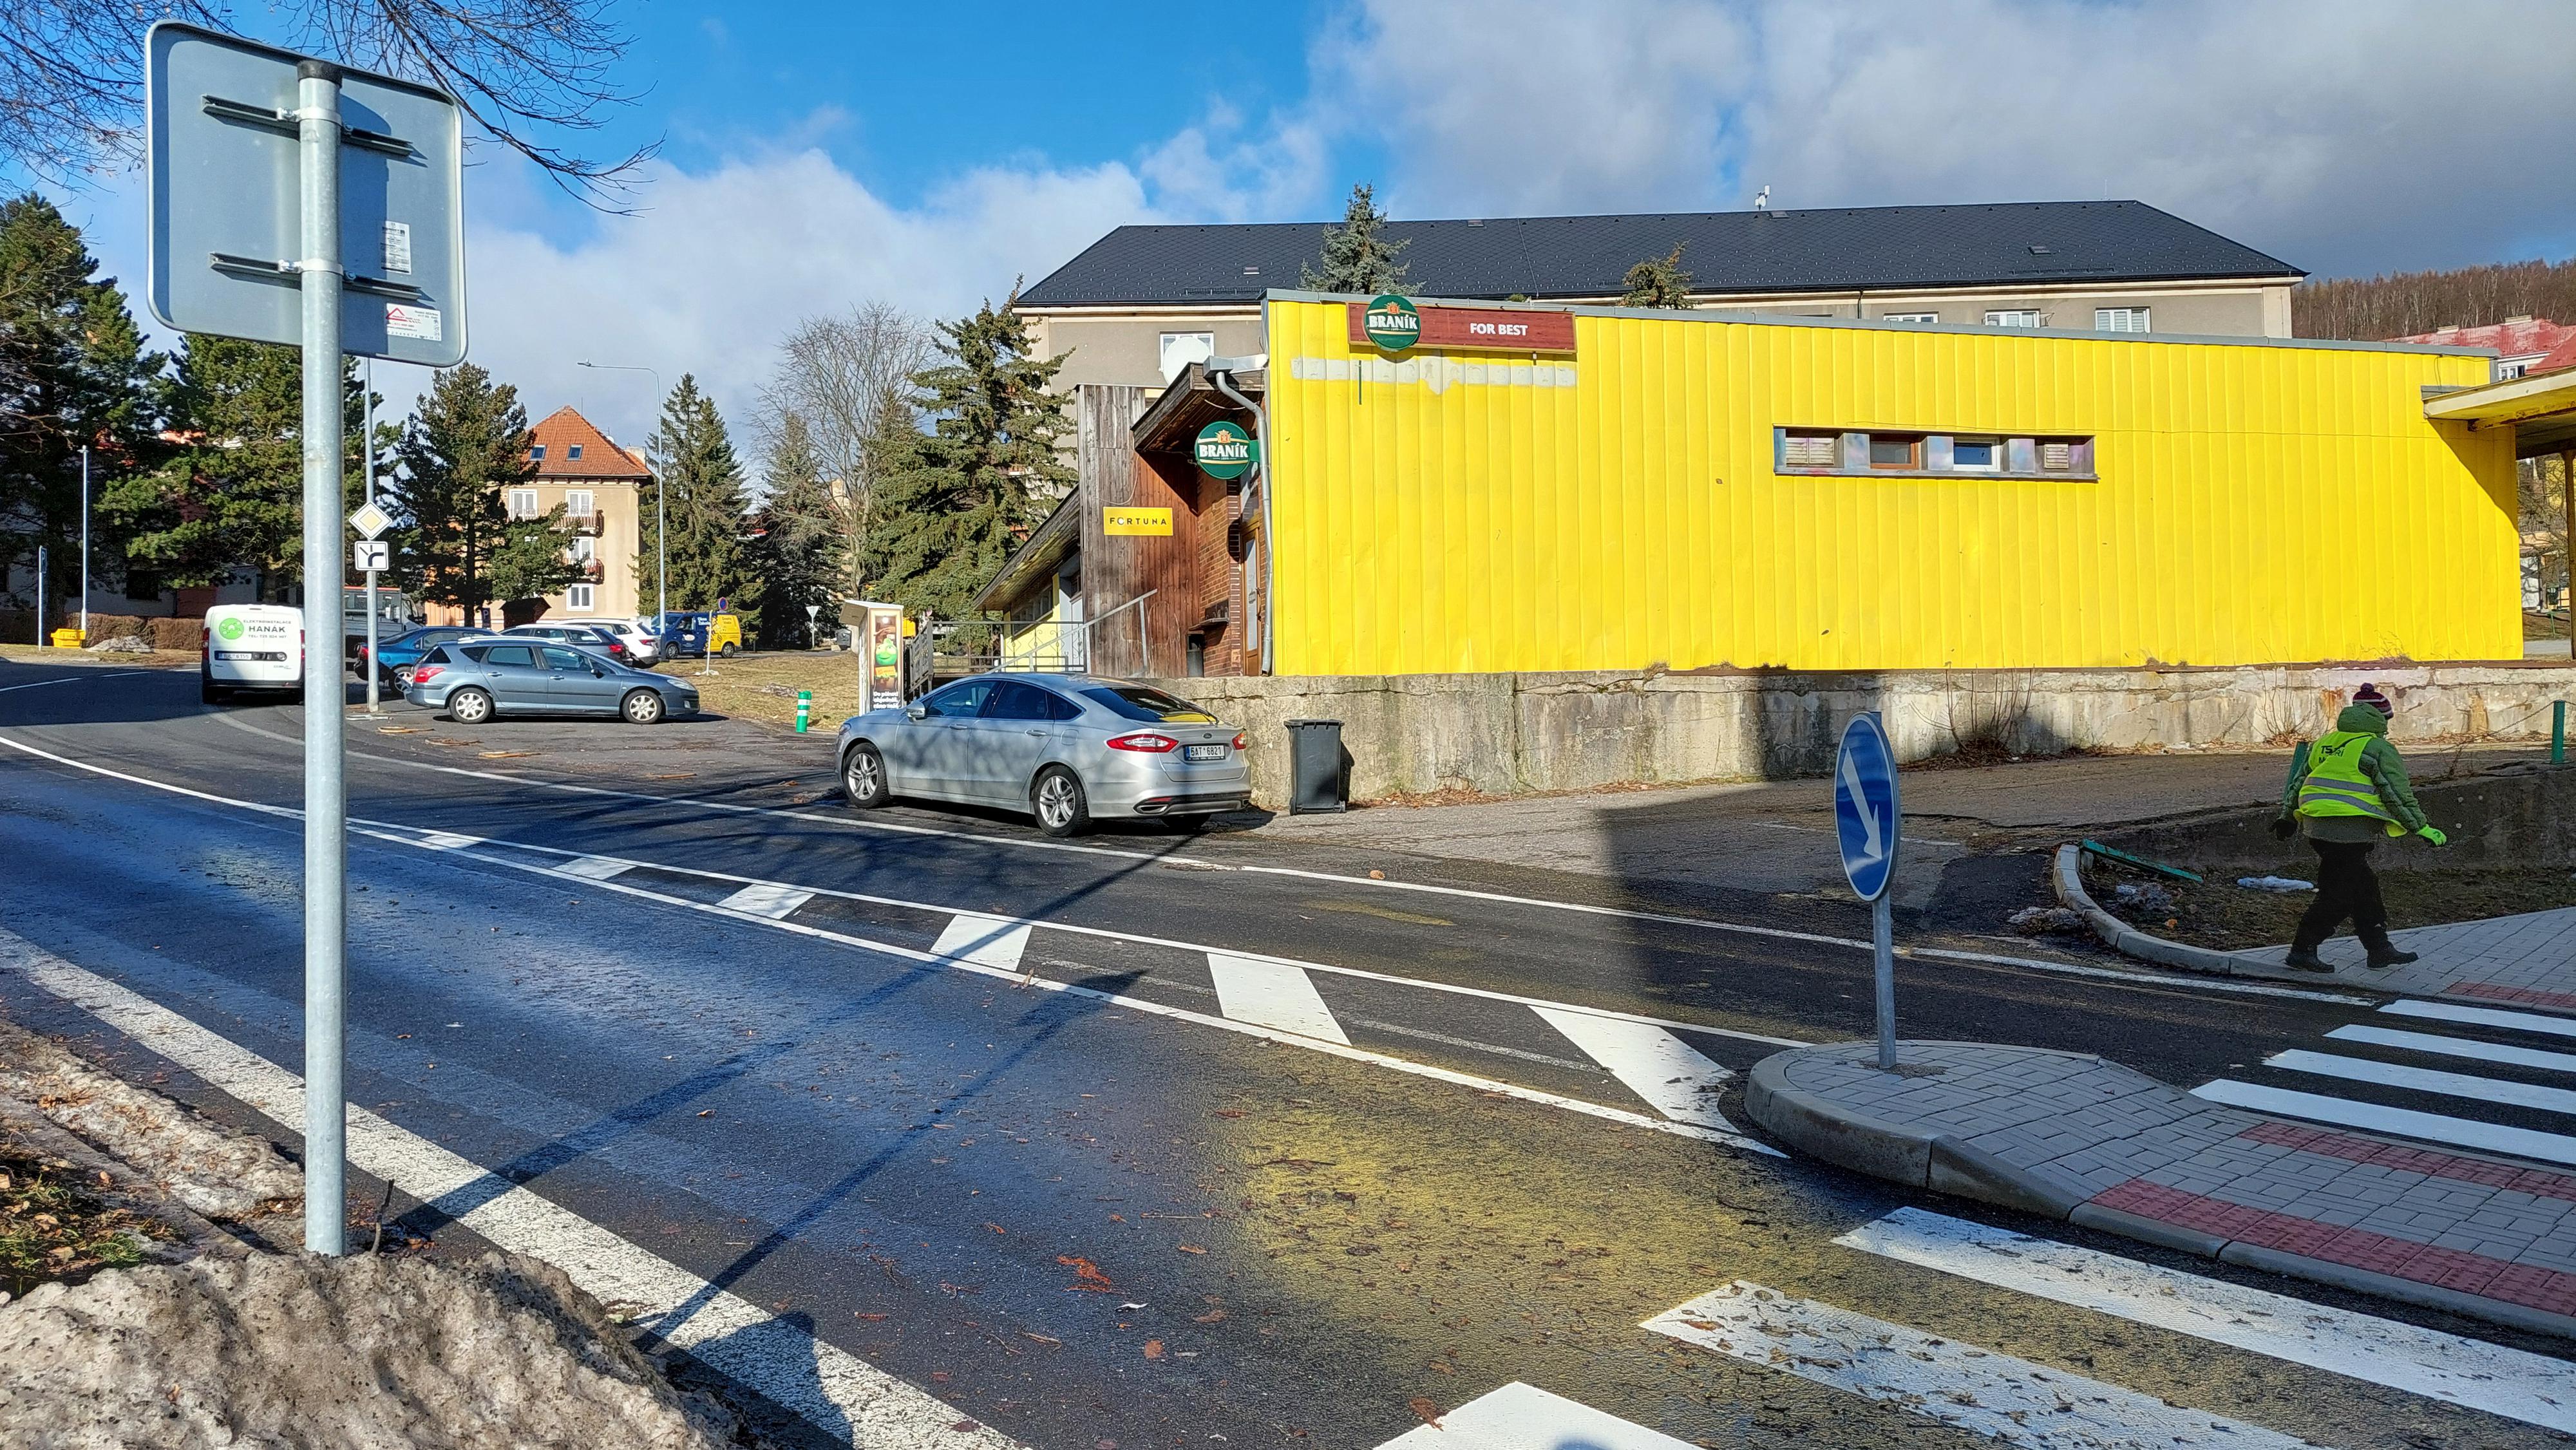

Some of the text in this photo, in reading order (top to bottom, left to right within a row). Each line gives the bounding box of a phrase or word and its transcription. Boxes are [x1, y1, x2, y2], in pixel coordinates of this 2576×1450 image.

[1368, 314, 1418, 329] BRANÍK
[1470, 323, 1528, 335] FOR BEST
[1198, 442, 1249, 458] BRANÍK
[483, 609, 489, 619] P
[1208, 747, 1221, 755] 6821
